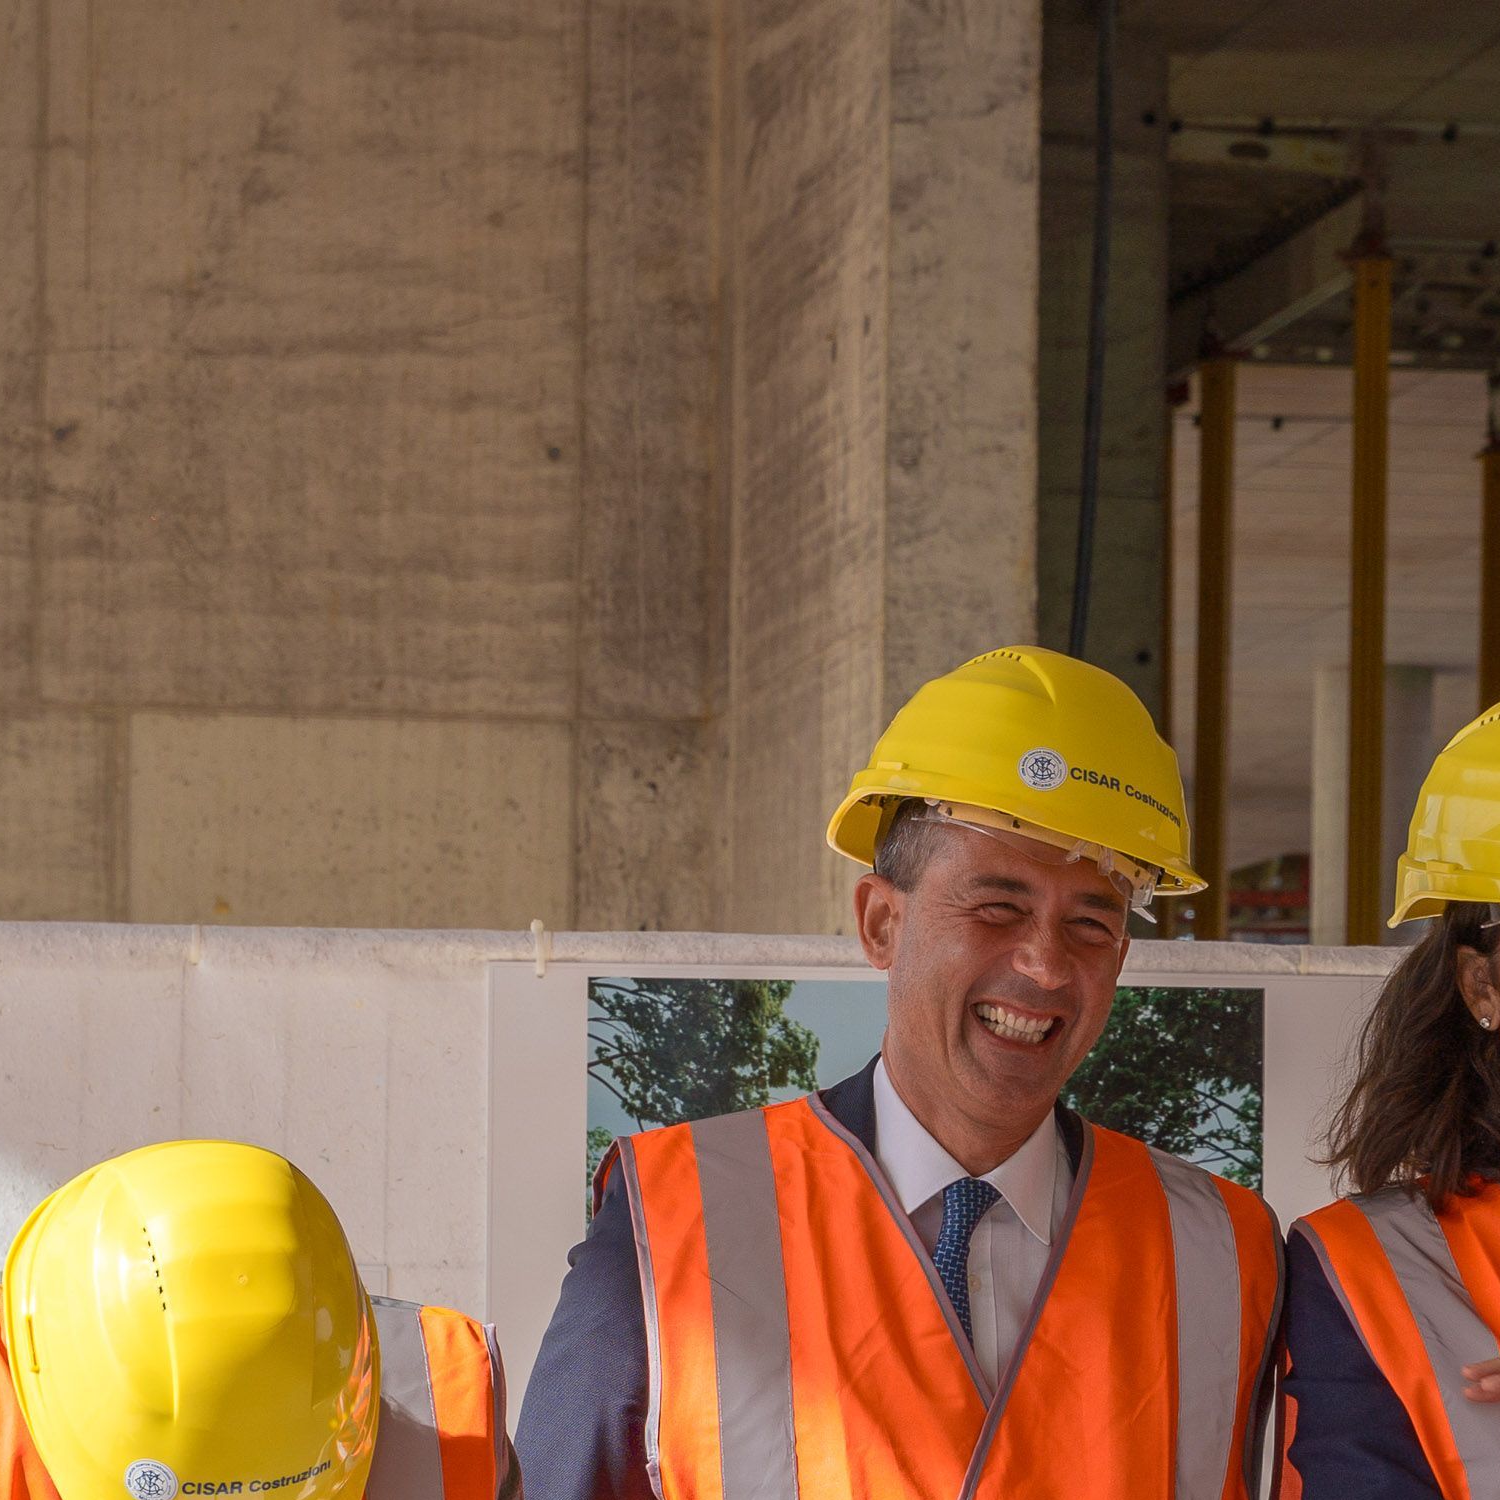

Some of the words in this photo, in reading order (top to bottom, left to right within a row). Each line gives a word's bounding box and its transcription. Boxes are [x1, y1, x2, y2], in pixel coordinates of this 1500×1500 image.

[1070, 766, 1121, 792] CISAR
[1124, 784, 1181, 828] Costruzioni
[182, 1481, 243, 1496] CISAR
[249, 1459, 332, 1493] Costruzioni
